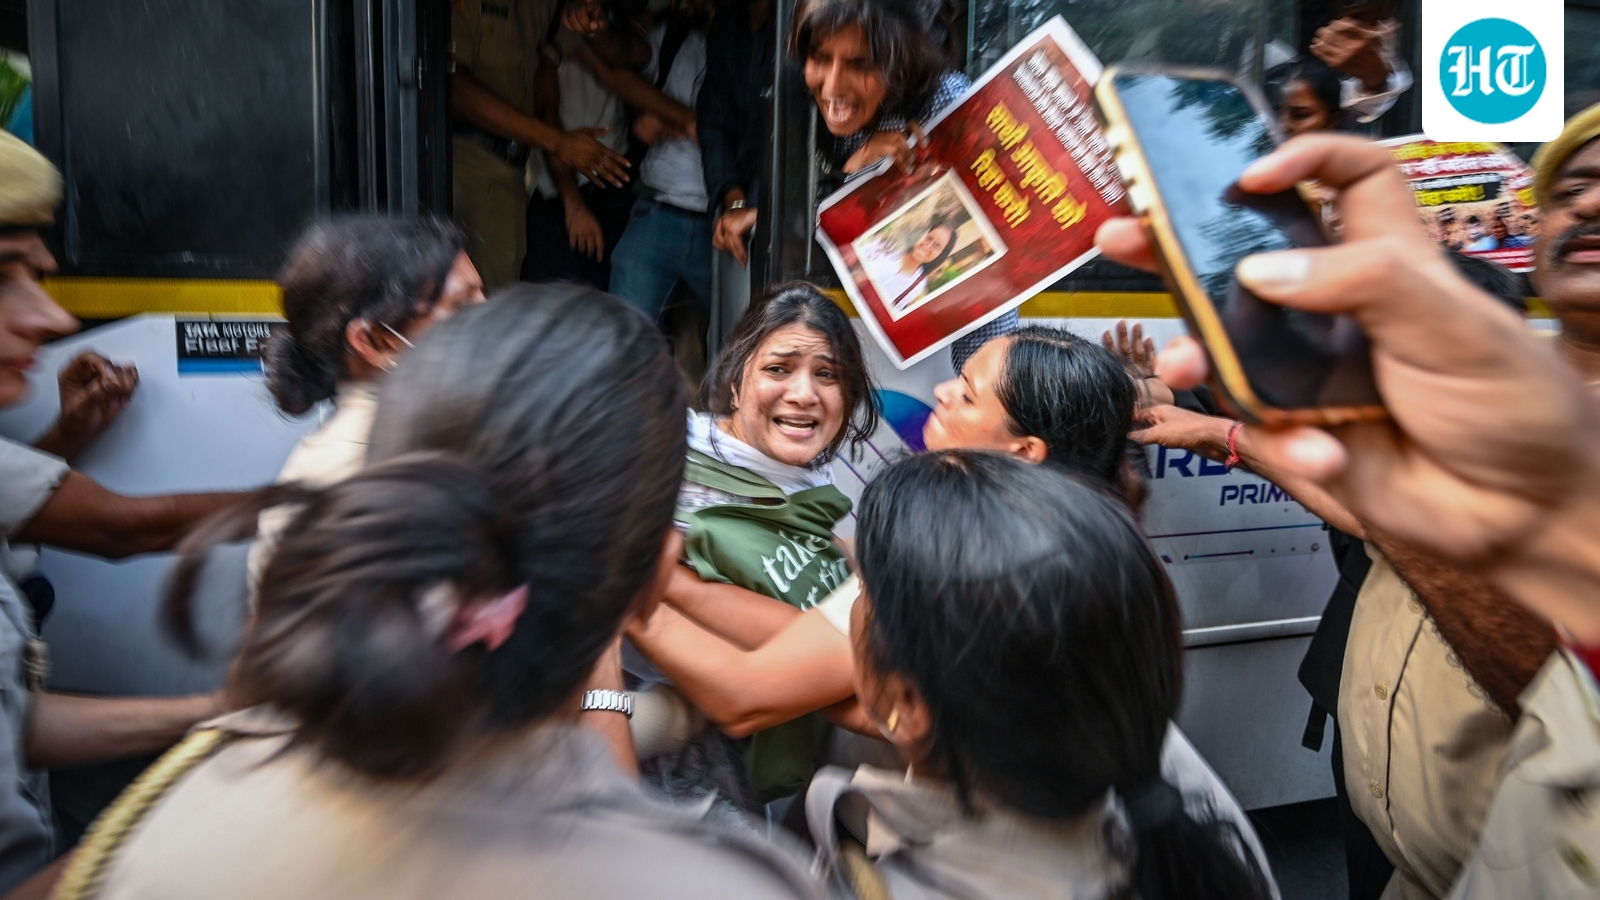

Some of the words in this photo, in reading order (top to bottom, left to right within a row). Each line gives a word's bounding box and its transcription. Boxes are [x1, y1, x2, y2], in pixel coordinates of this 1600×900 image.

[970, 147, 1006, 192] रिहा
[986, 100, 1030, 151] साथी
[1010, 138, 1069, 206] आकृति
[1051, 192, 1088, 231] को
[184, 322, 221, 338] TATA
[222, 322, 272, 338] MOTORS
[1220, 484, 1297, 506] PRIM
[760, 529, 831, 593] take
